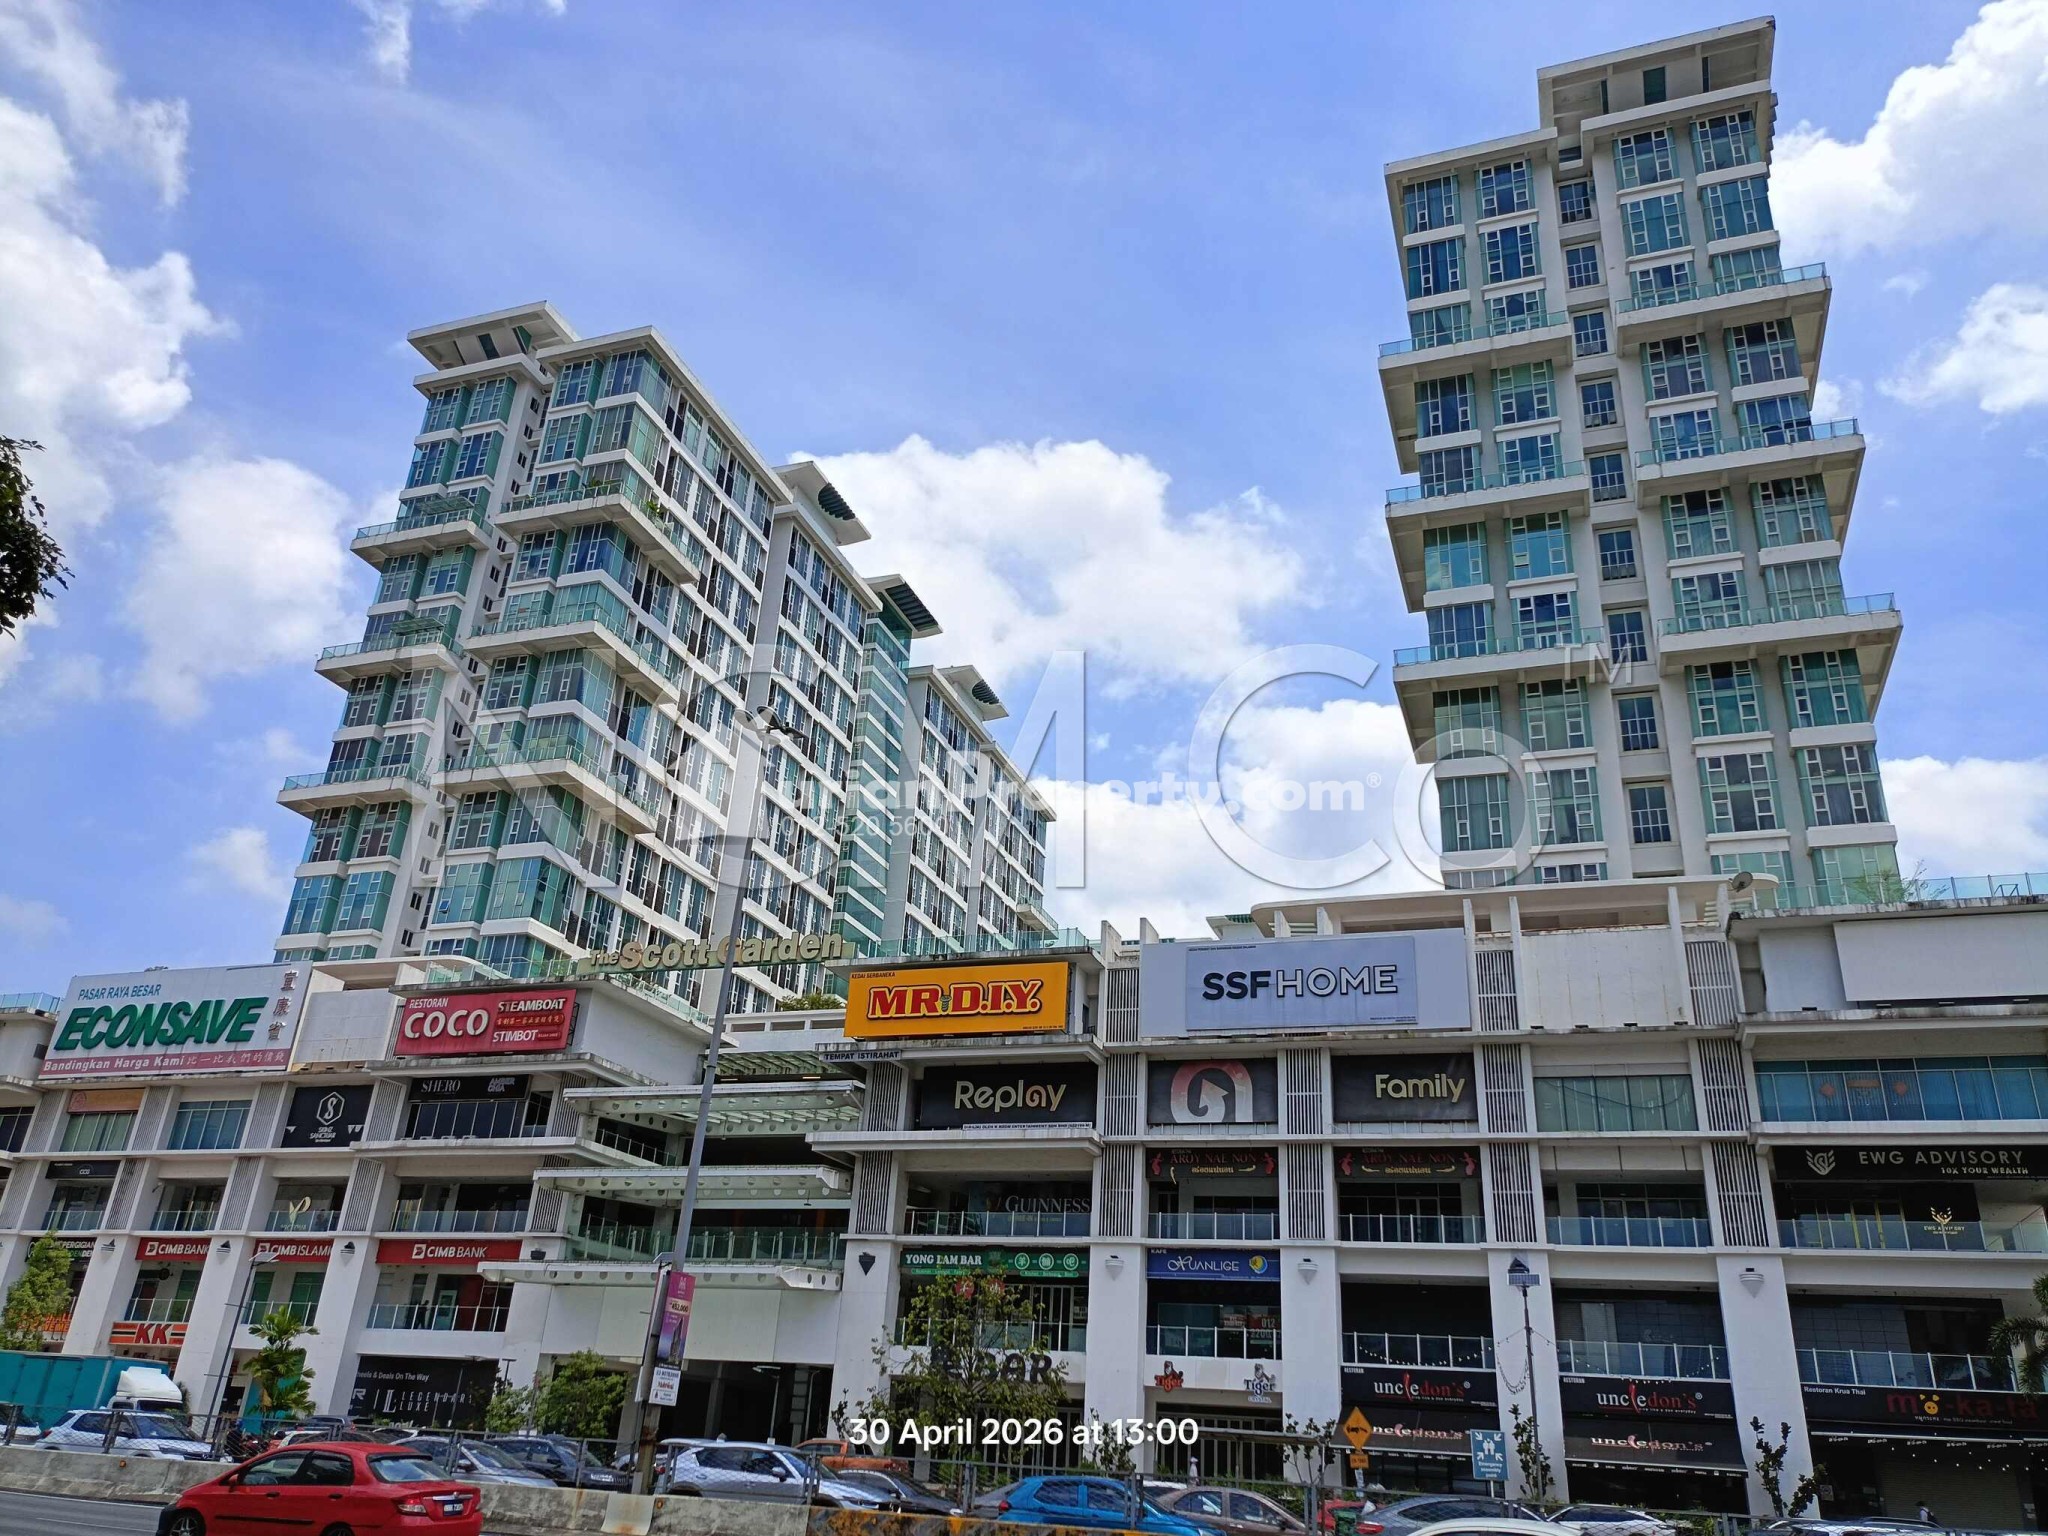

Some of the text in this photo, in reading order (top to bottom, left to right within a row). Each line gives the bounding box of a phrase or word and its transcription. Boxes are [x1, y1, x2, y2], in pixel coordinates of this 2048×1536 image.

[590, 931, 843, 969] The Scott Garden
[78, 983, 162, 1001] PASAR RAYA BESAR
[408, 997, 449, 1009] RESTORAN
[498, 997, 566, 1014] STEAMBOAT
[53, 996, 270, 1051] ECONSAVE
[404, 1008, 490, 1040] COCO
[492, 1029, 539, 1043] STIMBOT
[43, 1057, 111, 1073] Bandingkan
[114, 1056, 150, 1070] Harga
[153, 1054, 184, 1067] Kami
[825, 1051, 900, 1061] TEMPAT ISTIRAHAT
[421, 1079, 461, 1093] SHERO
[1375, 1073, 1465, 1103] Family
[954, 1079, 1067, 1113] Replay
[1170, 1153, 1200, 1164] AROY
[1858, 1150, 2024, 1165] EWG ADVISORY
[1962, 1167, 1989, 1175] YOUR
[1991, 1166, 2029, 1175] WEALTH
[1004, 1194, 1091, 1213] GUINNESS
[905, 1254, 934, 1265] YONG
[937, 1253, 959, 1266] LAM
[960, 1254, 982, 1266] BAR
[134, 1323, 172, 1345] KK
[357, 1370, 372, 1379] heels
[378, 1371, 394, 1380] Deals
[395, 1372, 404, 1380] On
[405, 1373, 416, 1381] The
[416, 1373, 430, 1383] Way
[1243, 1377, 1276, 1396] Tiger
[1803, 1386, 1833, 1395] Restoran
[1851, 1388, 1866, 1396] Thai
[400, 1401, 429, 1412] LUXE
